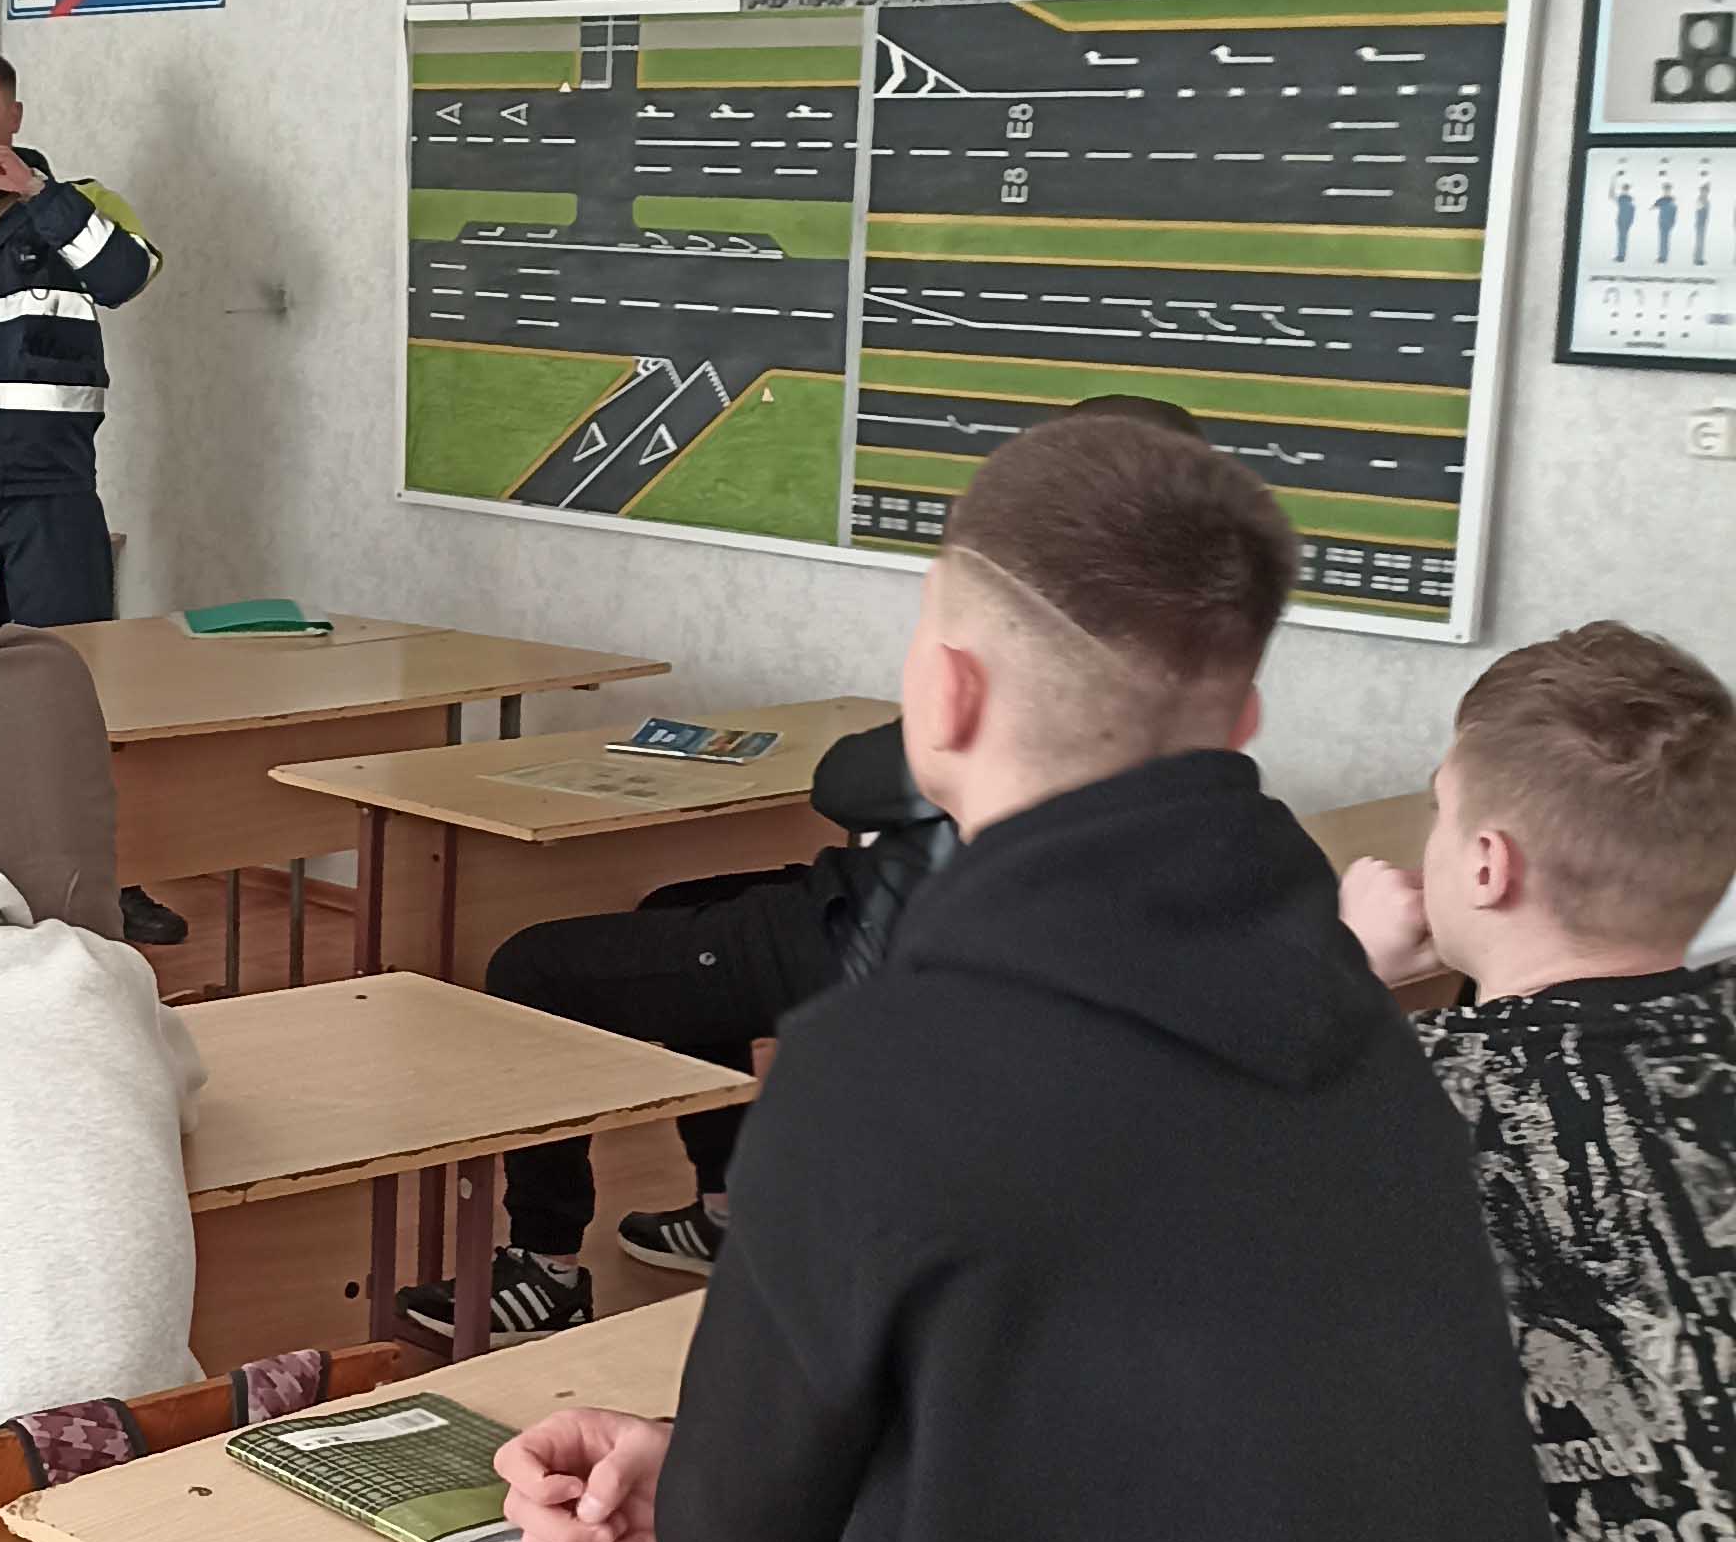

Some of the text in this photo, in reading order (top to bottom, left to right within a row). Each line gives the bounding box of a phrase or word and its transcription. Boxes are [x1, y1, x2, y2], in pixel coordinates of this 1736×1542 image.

[1006, 103, 1034, 139] E8
[1442, 101, 1477, 143] E8
[1001, 167, 1029, 203] E8
[1434, 173, 1469, 213] E8
